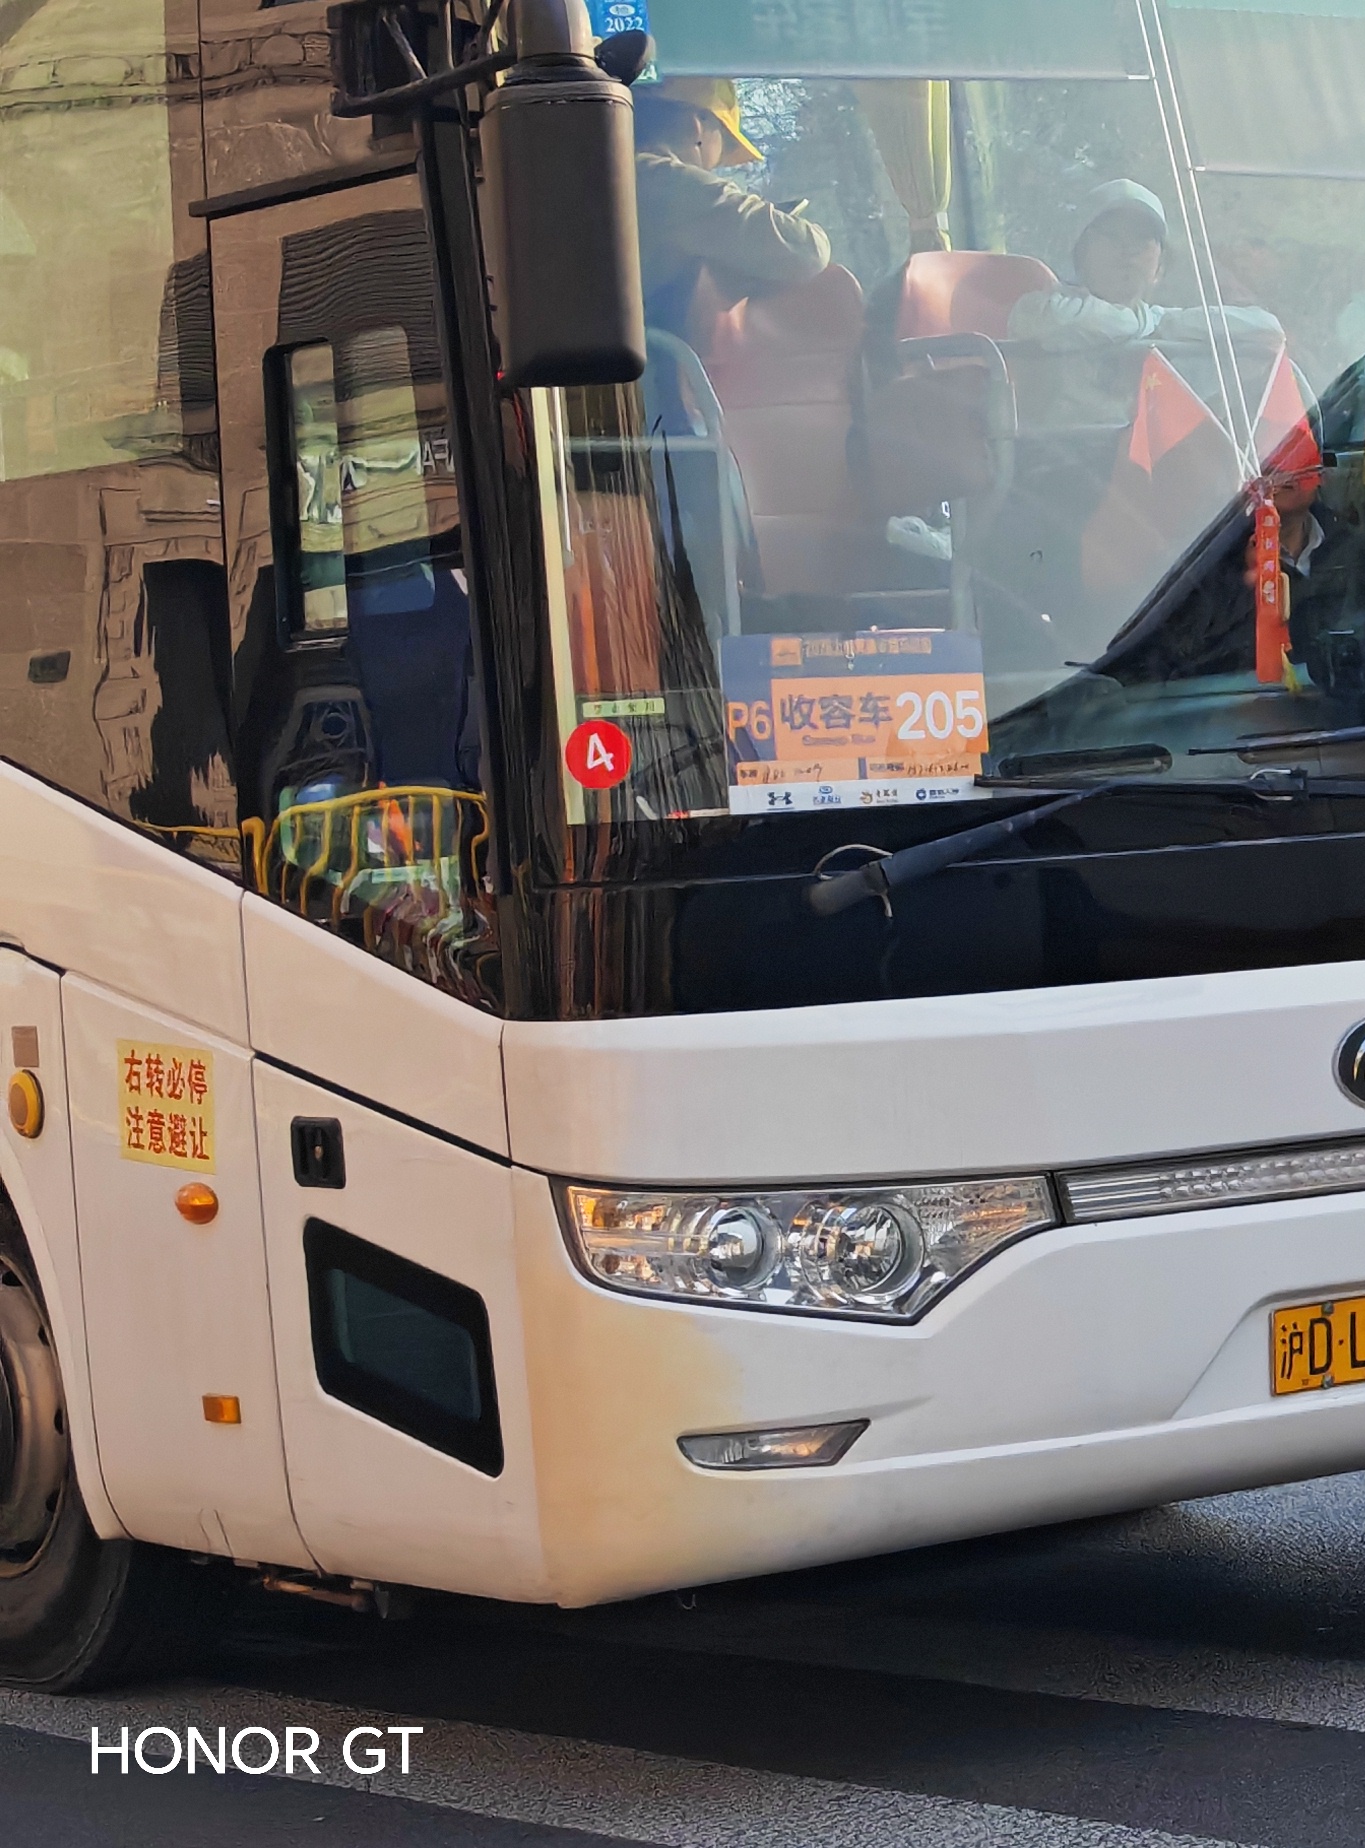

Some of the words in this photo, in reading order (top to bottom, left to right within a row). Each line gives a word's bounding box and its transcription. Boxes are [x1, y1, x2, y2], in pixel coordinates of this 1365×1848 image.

[605, 17, 645, 32] 2022
[727, 700, 773, 743] P6
[780, 692, 893, 732] 收容车
[896, 689, 984, 741] 205
[587, 732, 614, 772] 4
[124, 1049, 208, 1105] 右转必停
[126, 1106, 210, 1159] 注意避让
